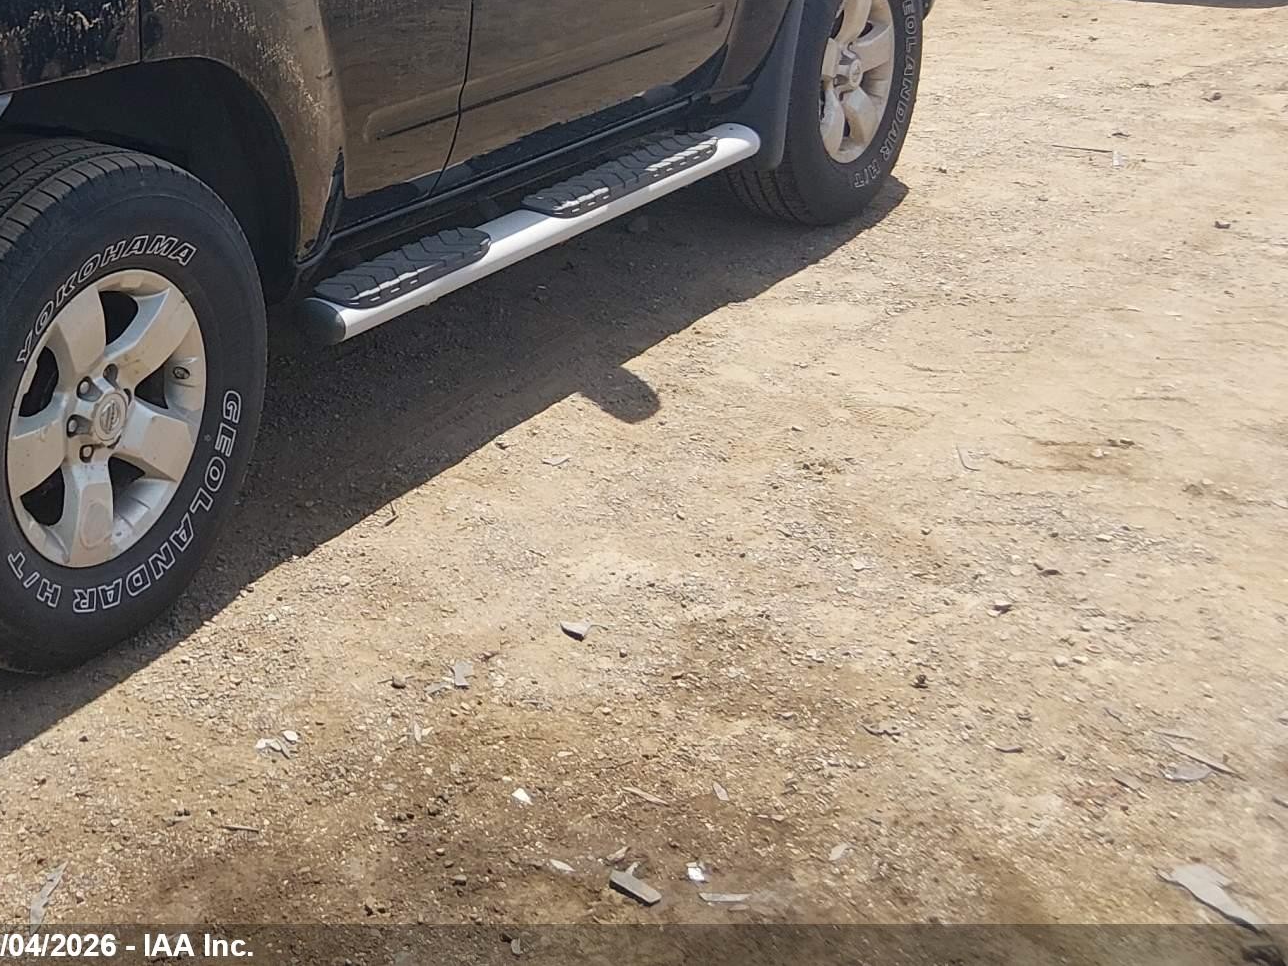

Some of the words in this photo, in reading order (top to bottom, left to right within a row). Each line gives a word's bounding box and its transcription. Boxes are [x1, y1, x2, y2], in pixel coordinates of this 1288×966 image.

[17, 234, 198, 365] YOKOHAMA
[73, 390, 242, 614] GEOLANDAR
[8, 550, 60, 608] H/T
